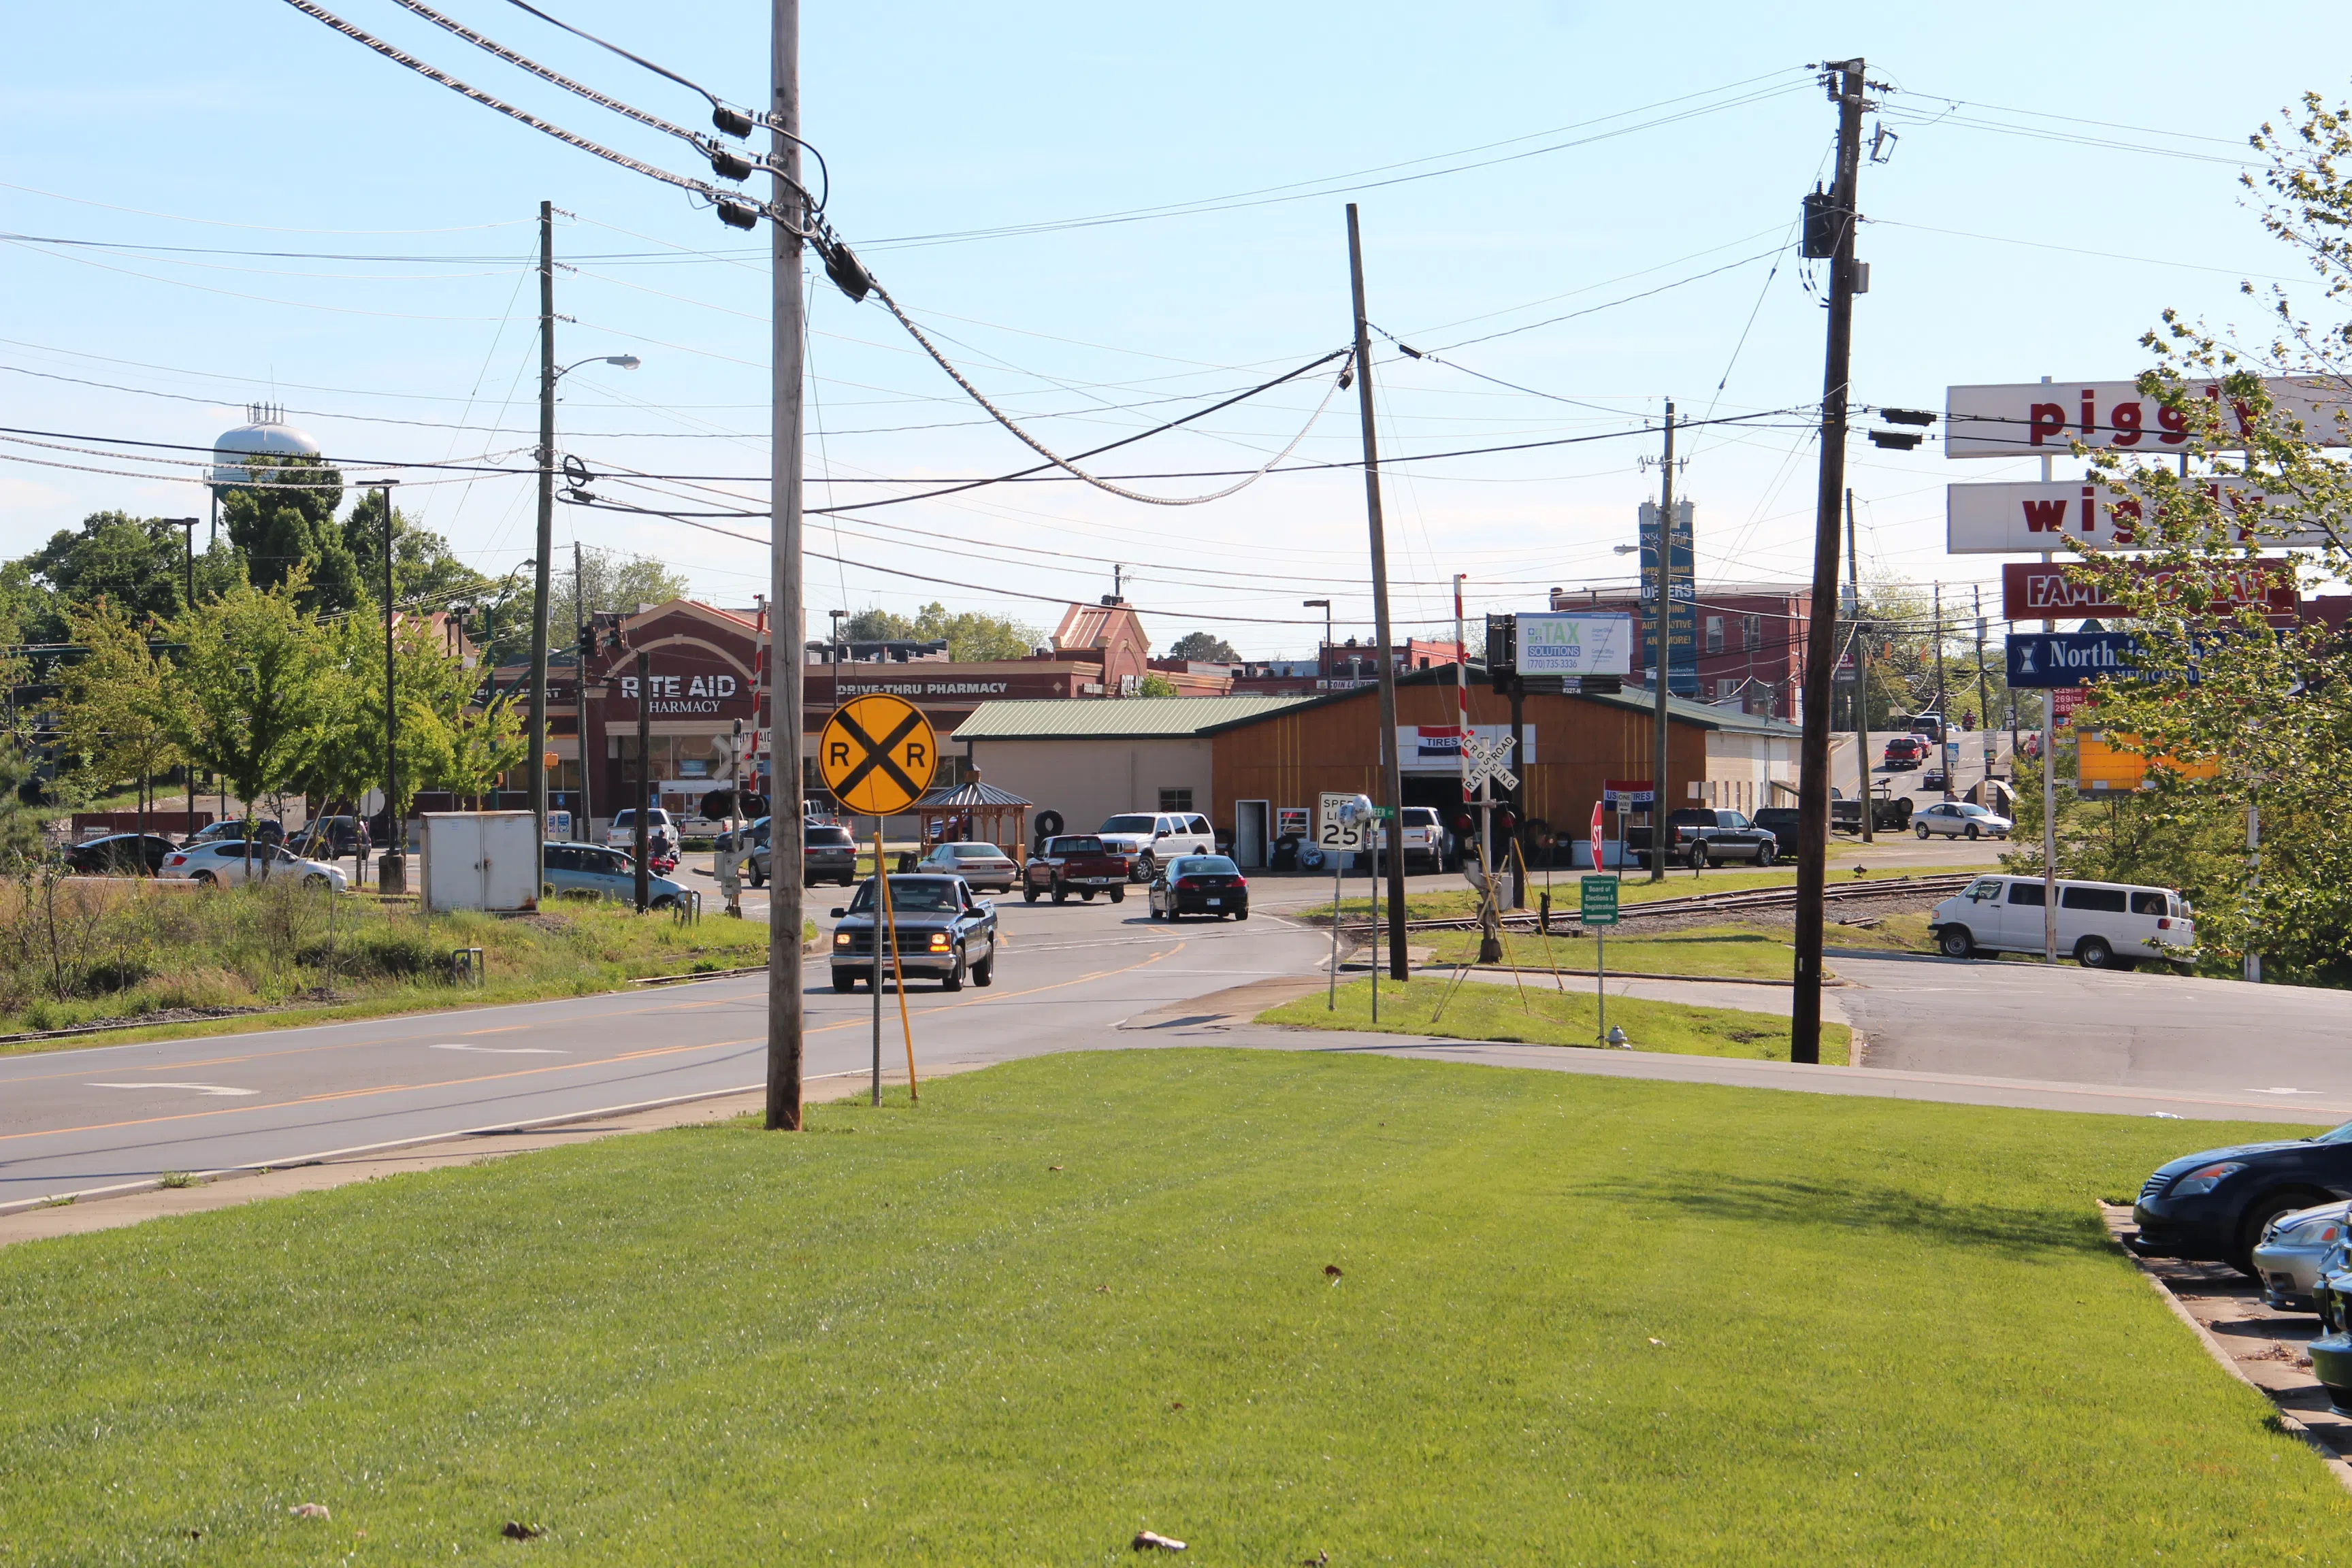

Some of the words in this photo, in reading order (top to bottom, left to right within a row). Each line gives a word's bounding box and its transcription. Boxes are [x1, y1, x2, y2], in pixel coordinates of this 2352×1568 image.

[1642, 619, 1693, 630] AUTOTIVE
[1541, 622, 1580, 644] TAX
[1529, 646, 1580, 657] SOLUTIONS
[1527, 659, 1546, 670] (770)
[1546, 659, 1578, 669] 735-3336
[621, 675, 681, 698] RTE
[688, 675, 736, 698] AID
[836, 684, 922, 696] DRIVE-THRU
[927, 683, 1007, 694] PHARMACY
[2055, 695, 2071, 703] 269
[649, 700, 721, 713] HARMACY
[1426, 737, 1458, 747] TIRES
[830, 742, 850, 767] R
[906, 742, 926, 768] R
[1463, 738, 1516, 789] CROSSING
[1322, 823, 1359, 845] 25
